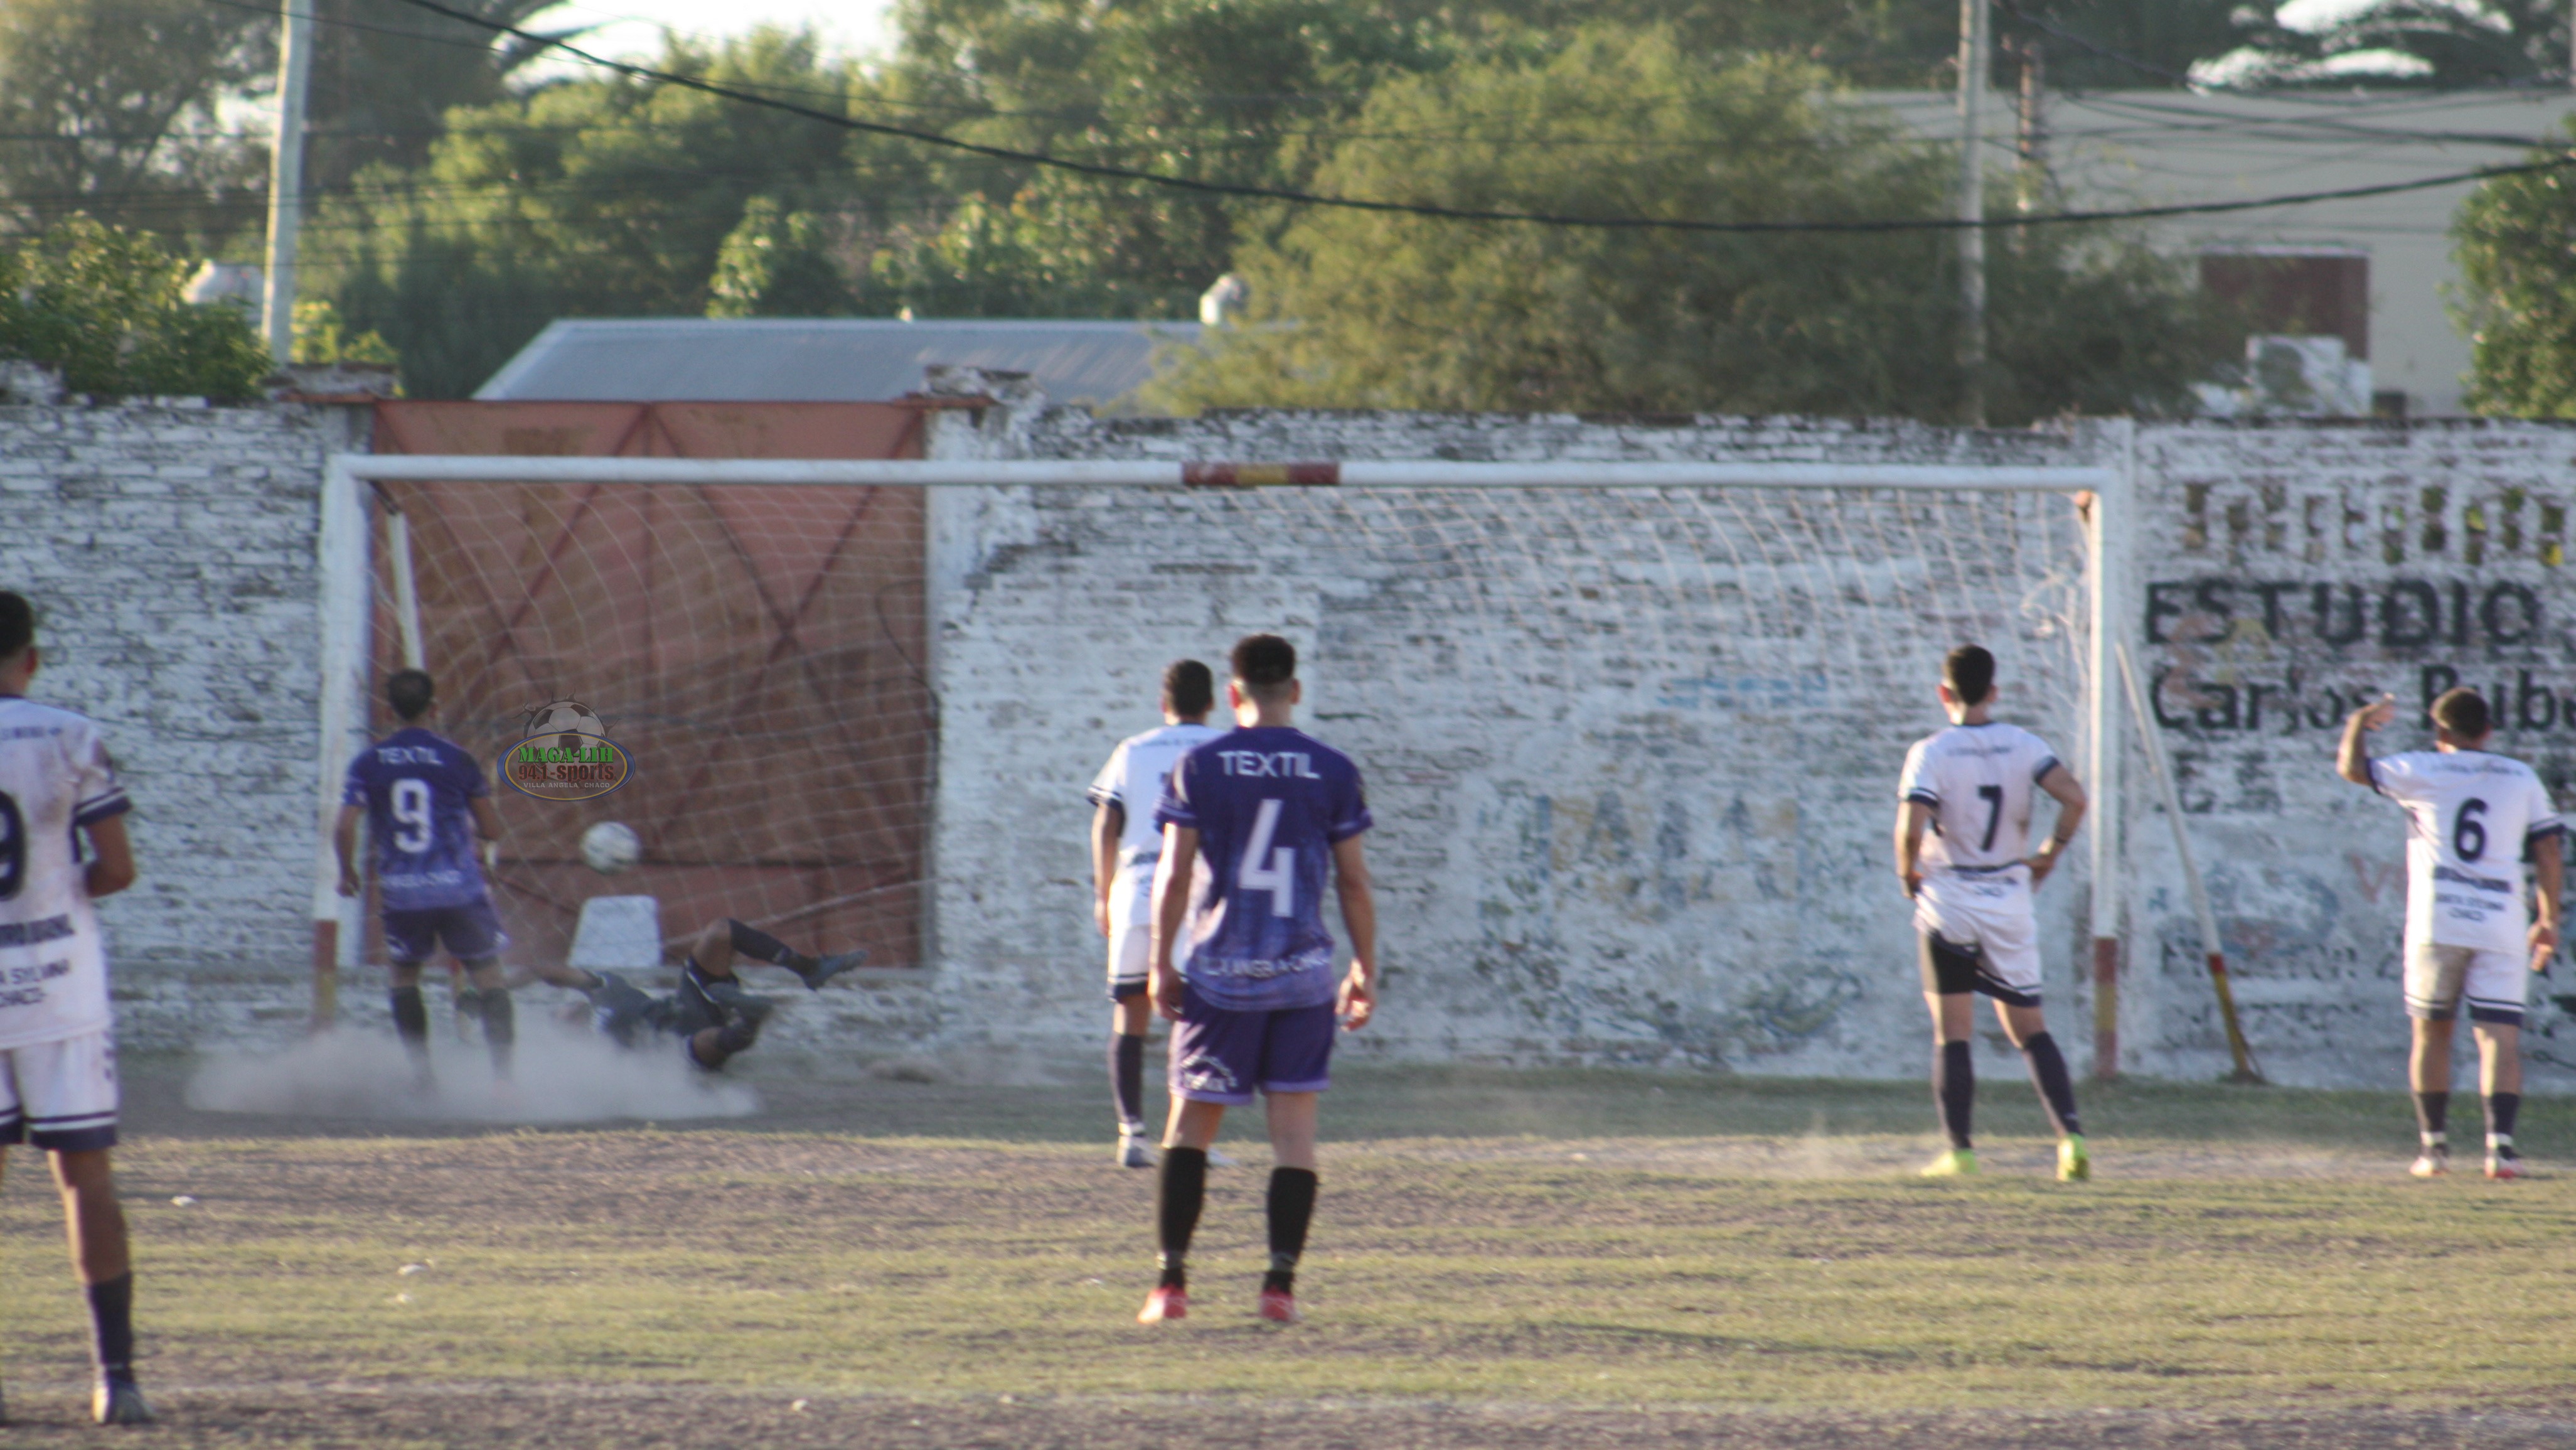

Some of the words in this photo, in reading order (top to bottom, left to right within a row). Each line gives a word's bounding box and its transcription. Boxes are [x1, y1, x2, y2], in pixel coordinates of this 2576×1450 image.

[2146, 579, 2538, 647] ESTUDIO
[377, 746, 443, 765] TEXTIL
[1217, 751, 1320, 780] TEXTIL
[390, 778, 433, 852] 9
[1978, 785, 2003, 851] 7
[2454, 797, 2488, 862] 6
[1239, 798, 1295, 917] 4
